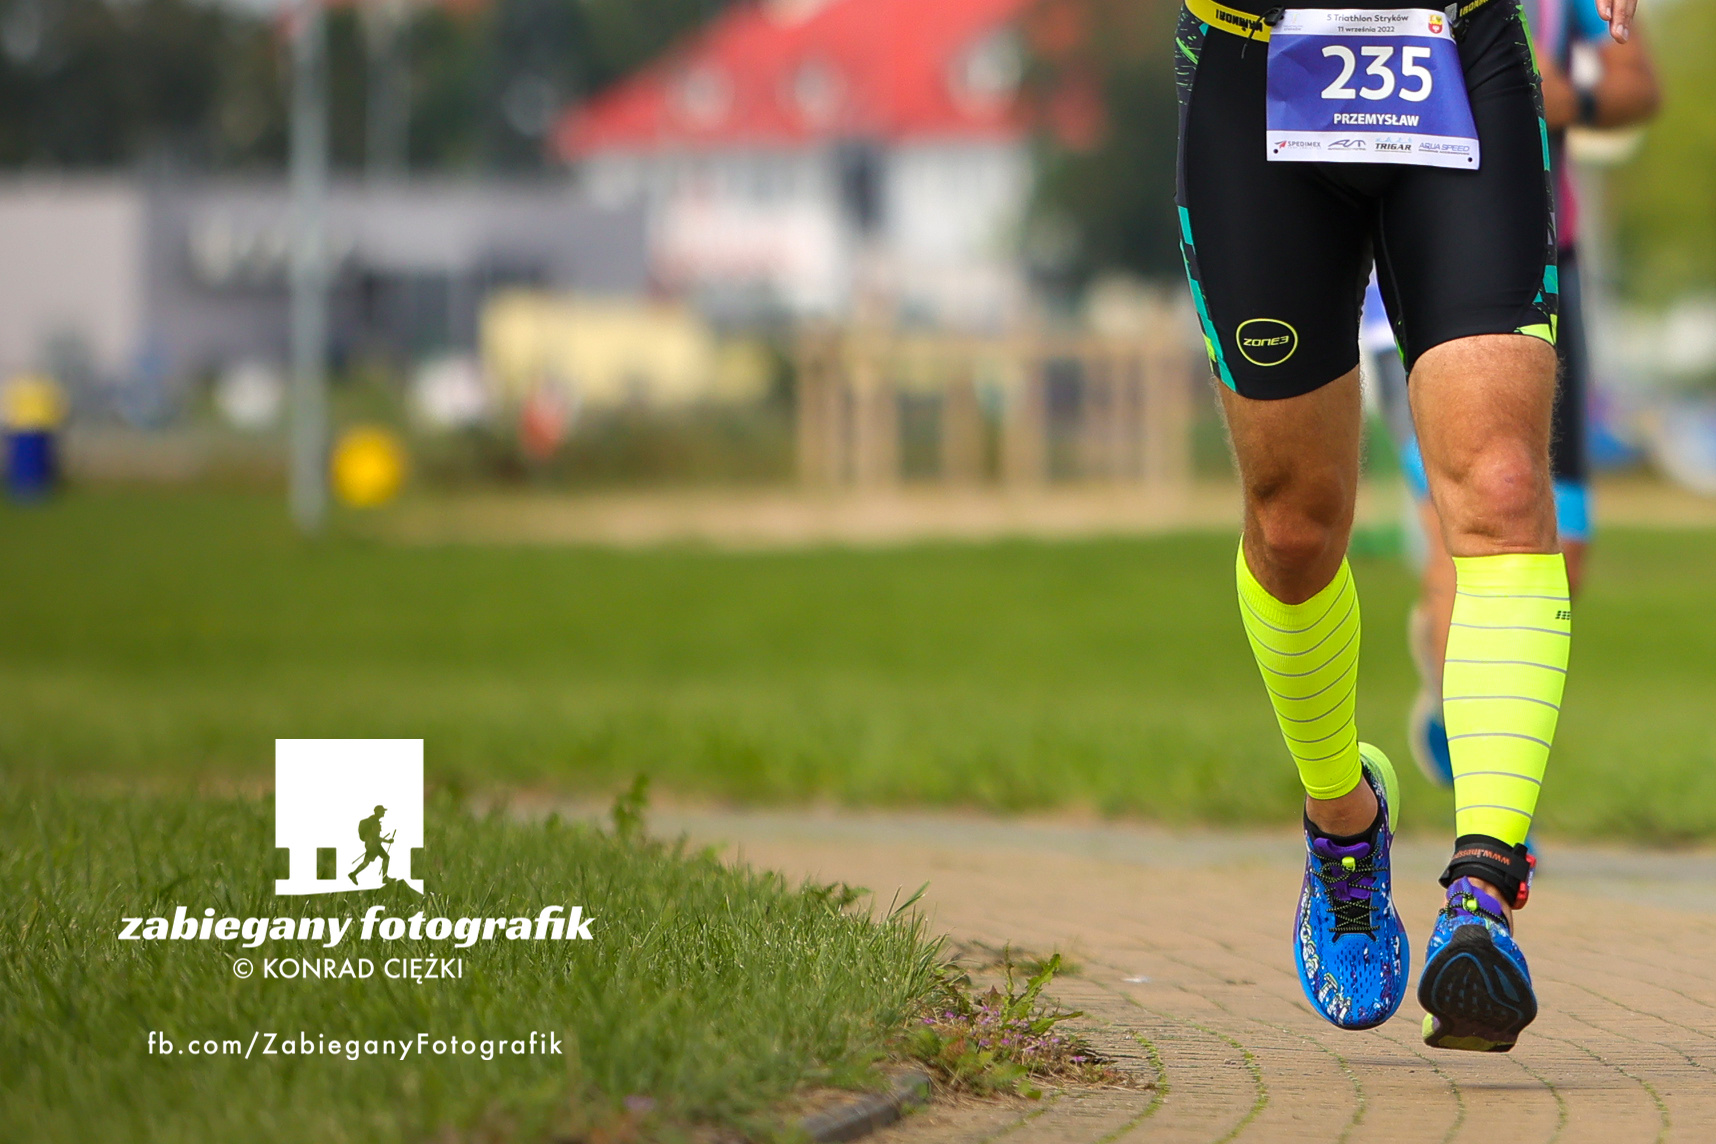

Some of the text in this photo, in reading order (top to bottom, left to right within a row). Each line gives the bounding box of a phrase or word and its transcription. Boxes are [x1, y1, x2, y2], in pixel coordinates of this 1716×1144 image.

[1327, 13, 1409, 24] 5 Triathlon Stryków
[1320, 45, 1433, 102] 235
[1333, 112, 1420, 127] PRZEMYSŁAW
[1374, 142, 1412, 151] TRIGAR
[1441, 144, 1470, 152] SPEED
[1243, 335, 1290, 347] ZONE3
